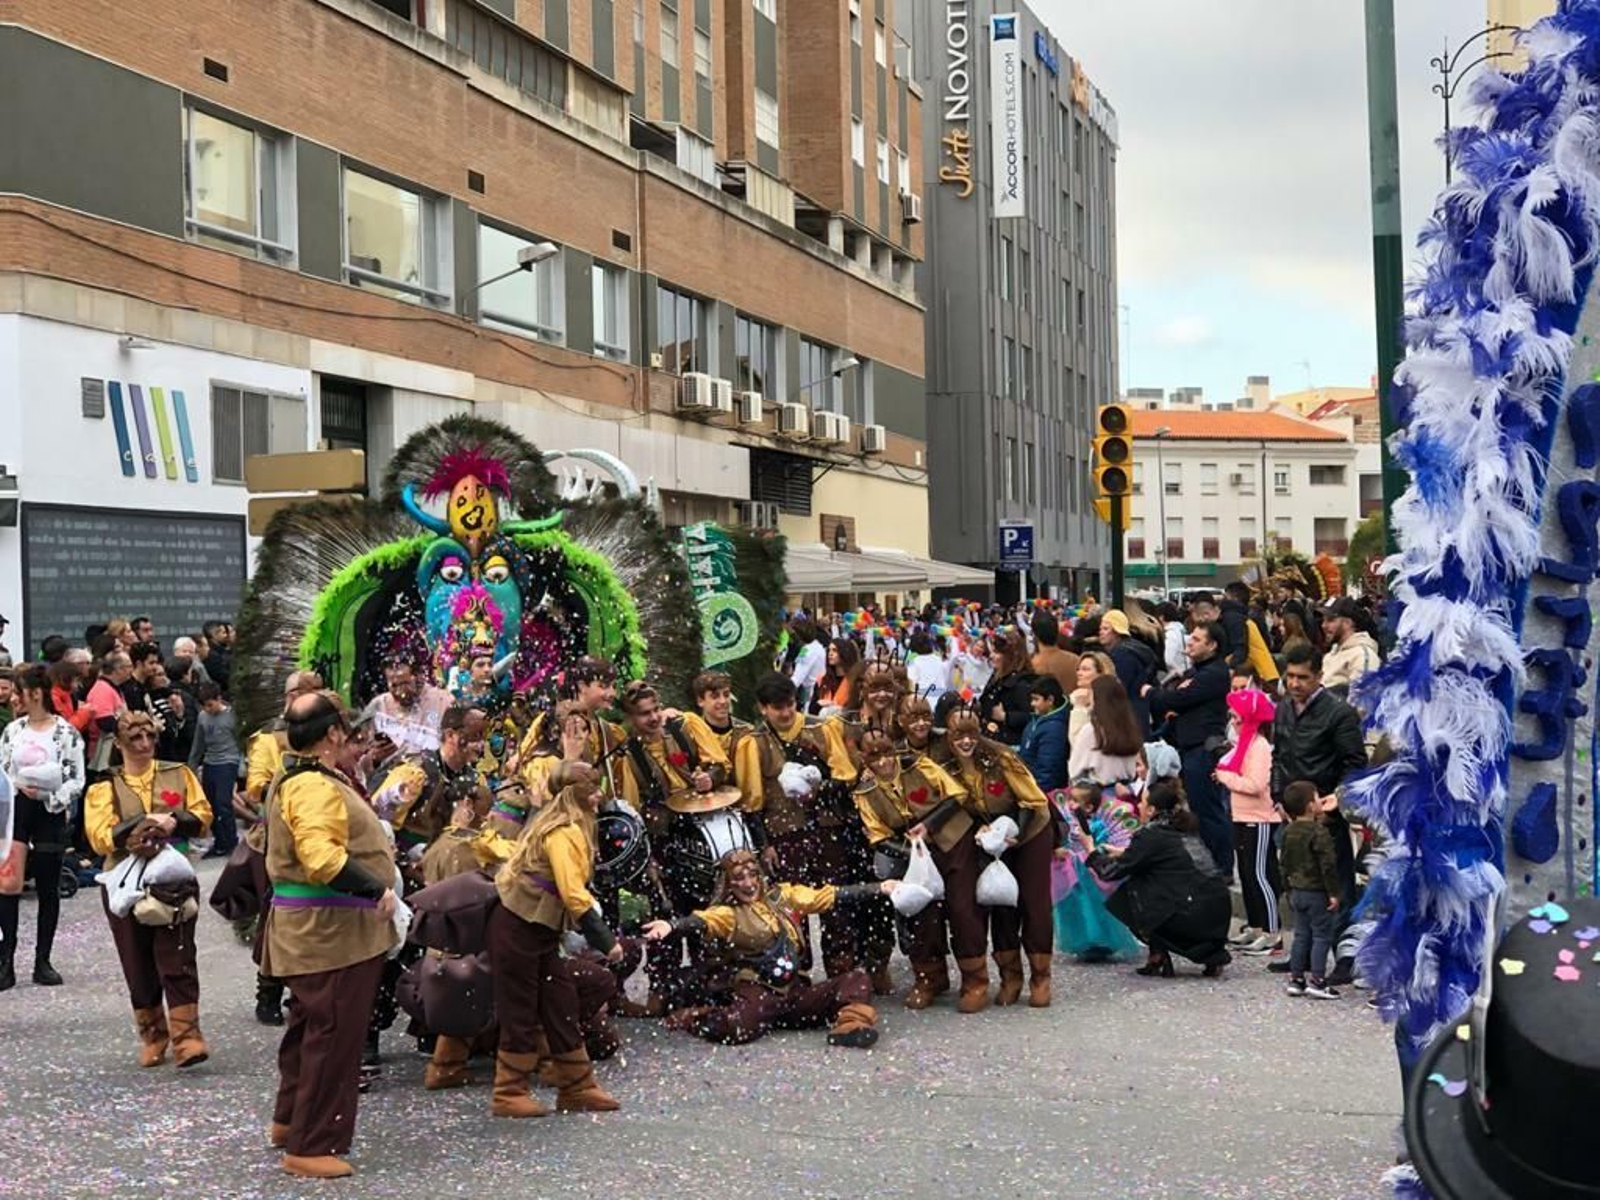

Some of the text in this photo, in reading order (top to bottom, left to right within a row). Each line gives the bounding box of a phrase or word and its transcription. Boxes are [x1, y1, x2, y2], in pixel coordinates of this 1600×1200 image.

[944, 0, 969, 120] NOVOT
[1005, 52, 1018, 199] ACCORHOTELS.COM
[1004, 529, 1018, 547] P
